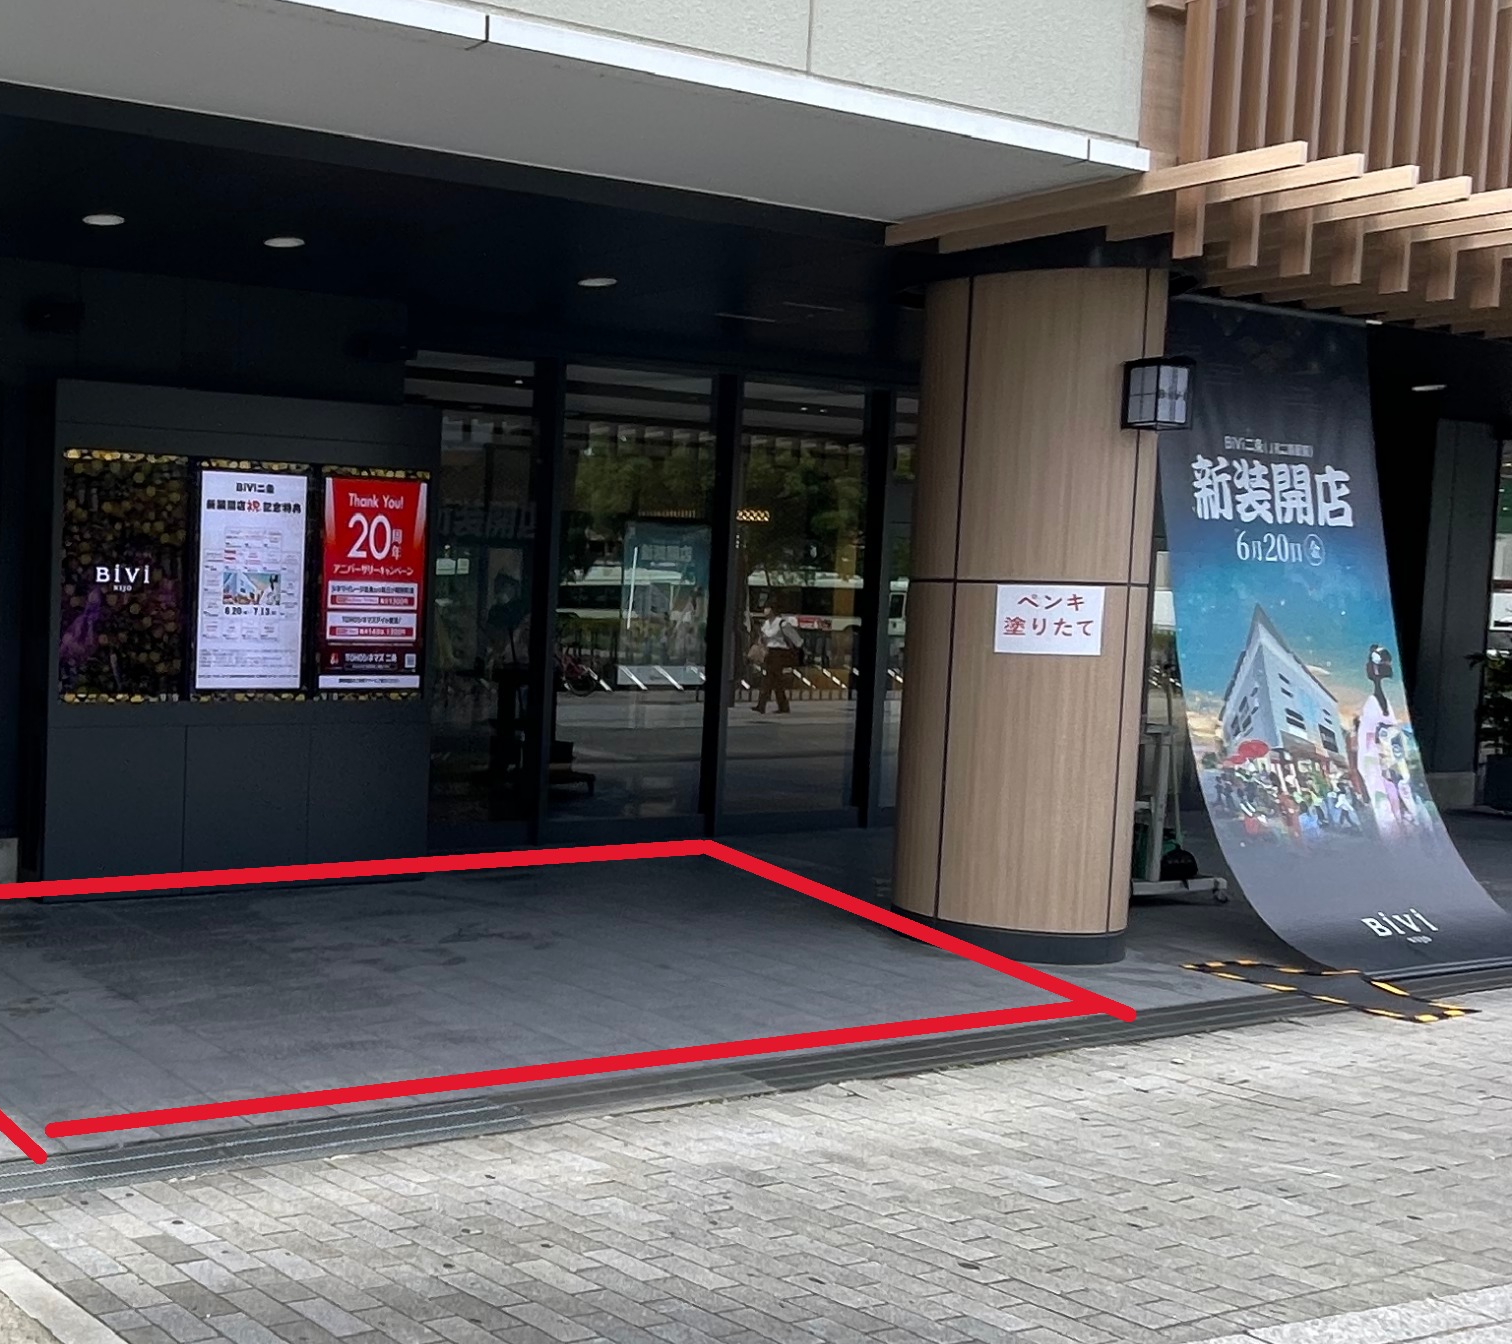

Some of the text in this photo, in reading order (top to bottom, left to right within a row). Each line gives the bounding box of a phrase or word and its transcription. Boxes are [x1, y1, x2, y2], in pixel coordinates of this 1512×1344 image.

[348, 492, 404, 509] Thank You!
[1191, 454, 1353, 527] 新装開店
[347, 512, 392, 561] 20
[391, 528, 403, 561] 周年
[96, 564, 150, 584] BiVi
[333, 563, 414, 576] アニバーサリーキャンペーン
[1017, 594, 1084, 611] ペンキ
[1003, 616, 1093, 636] 塗りたて
[1361, 907, 1439, 936] BiVi
